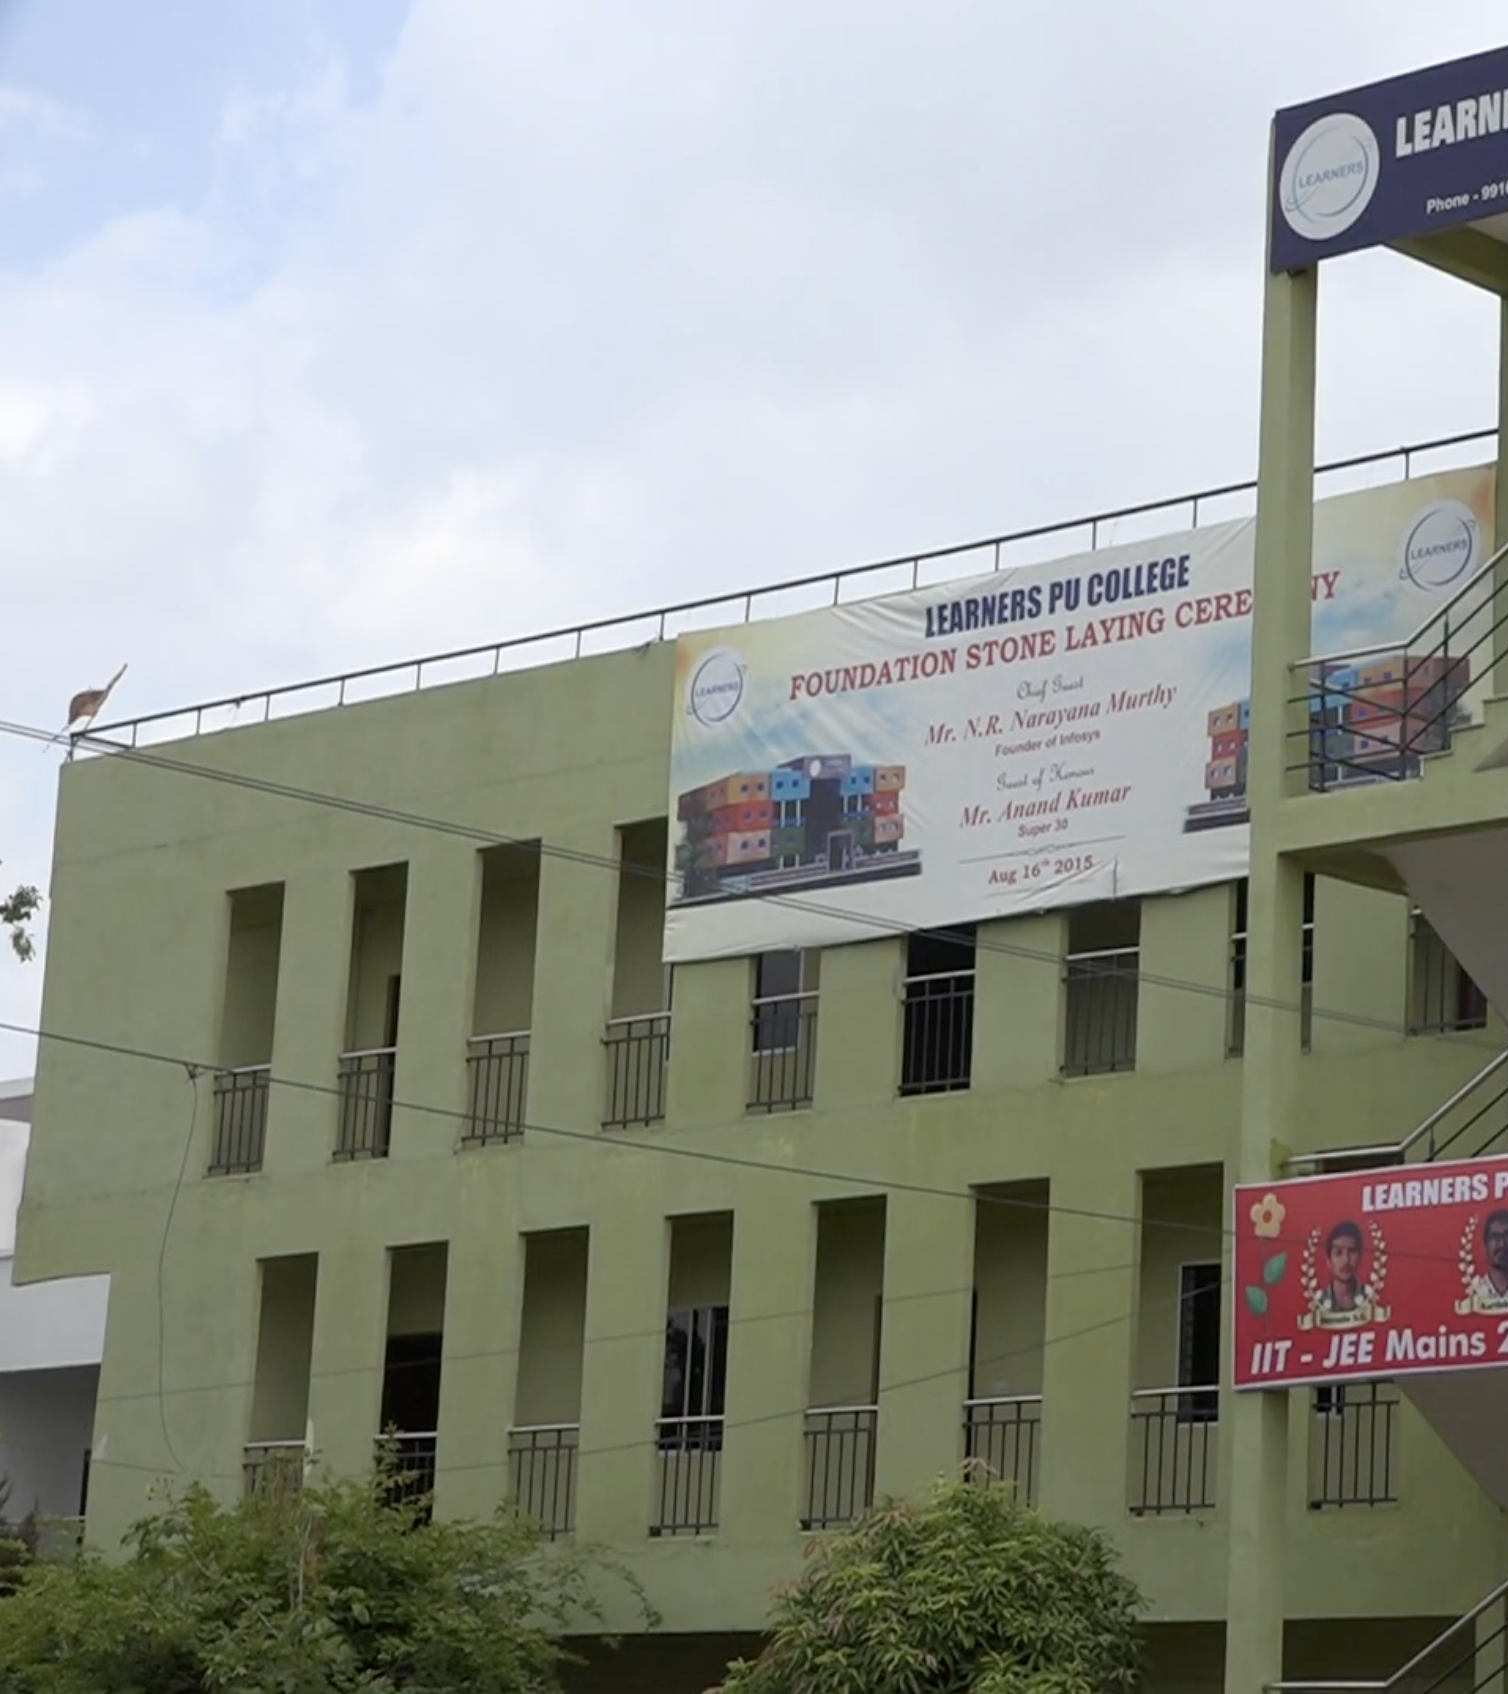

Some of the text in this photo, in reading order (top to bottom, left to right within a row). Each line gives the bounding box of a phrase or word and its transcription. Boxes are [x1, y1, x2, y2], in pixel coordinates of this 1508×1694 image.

[1298, 161, 1364, 188] LEARNERS
[1426, 194, 1470, 215] Phone
[1411, 538, 1468, 560] LEARNERS
[925, 554, 1190, 639] LEARNERS PU COLLEGE
[789, 647, 957, 701] FOUNDATION
[965, 629, 1057, 670] STONE
[1065, 605, 1165, 653] LAYING
[1016, 674, 1084, 703] Chief Guest
[925, 683, 1178, 747] Mr. N.R. Narayana Murthy
[994, 728, 1101, 758] Founder of Infosys
[996, 771, 1029, 792] Guest
[1032, 767, 1045, 791] of
[959, 784, 1132, 828] Mr. Anand Kumar
[1017, 817, 1069, 838] Super 30
[988, 854, 1094, 885] Aug 16th 2015
[1361, 1173, 1489, 1212] LEARNERS
[1250, 1340, 1292, 1375] IIT
[1300, 1352, 1314, 1364] -
[1322, 1331, 1376, 1369] JEE
[1384, 1325, 1487, 1362] Mains
